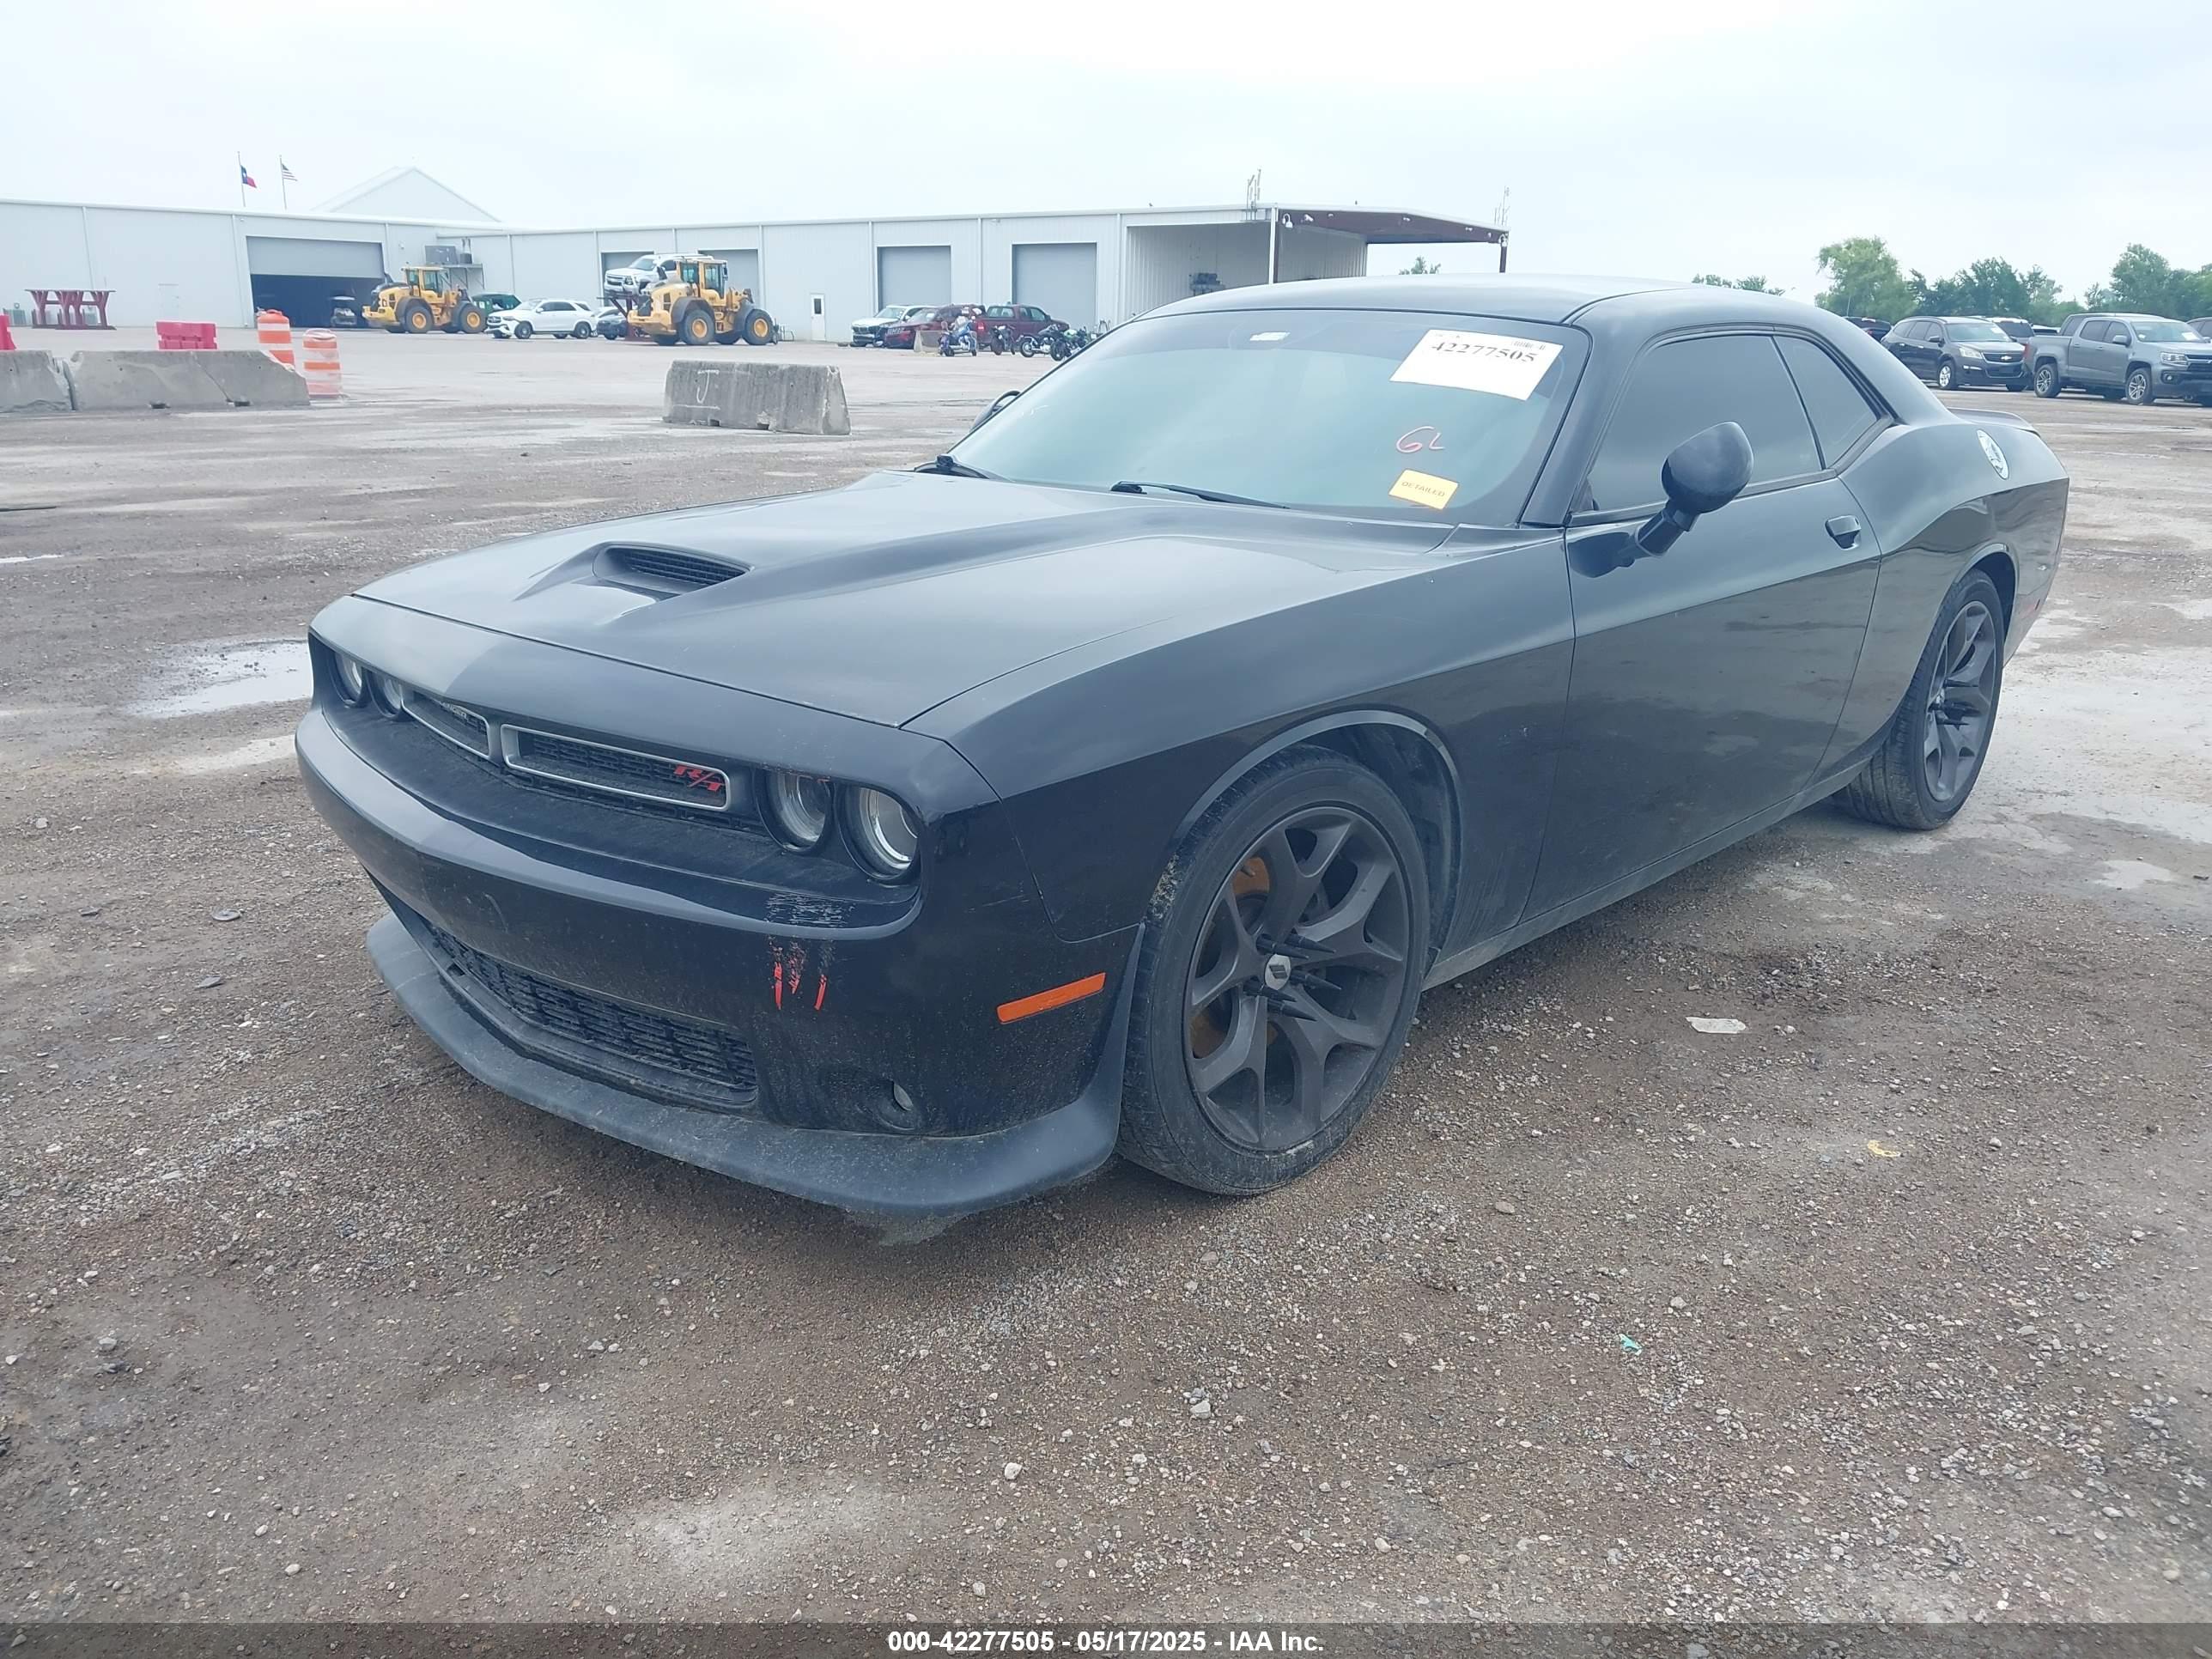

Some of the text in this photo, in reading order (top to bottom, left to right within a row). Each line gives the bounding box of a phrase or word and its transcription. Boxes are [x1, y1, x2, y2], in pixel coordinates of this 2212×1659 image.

[1432, 341, 1539, 362] 42277505
[1401, 481, 1445, 497] DETAILED
[672, 763, 726, 792] R/T
